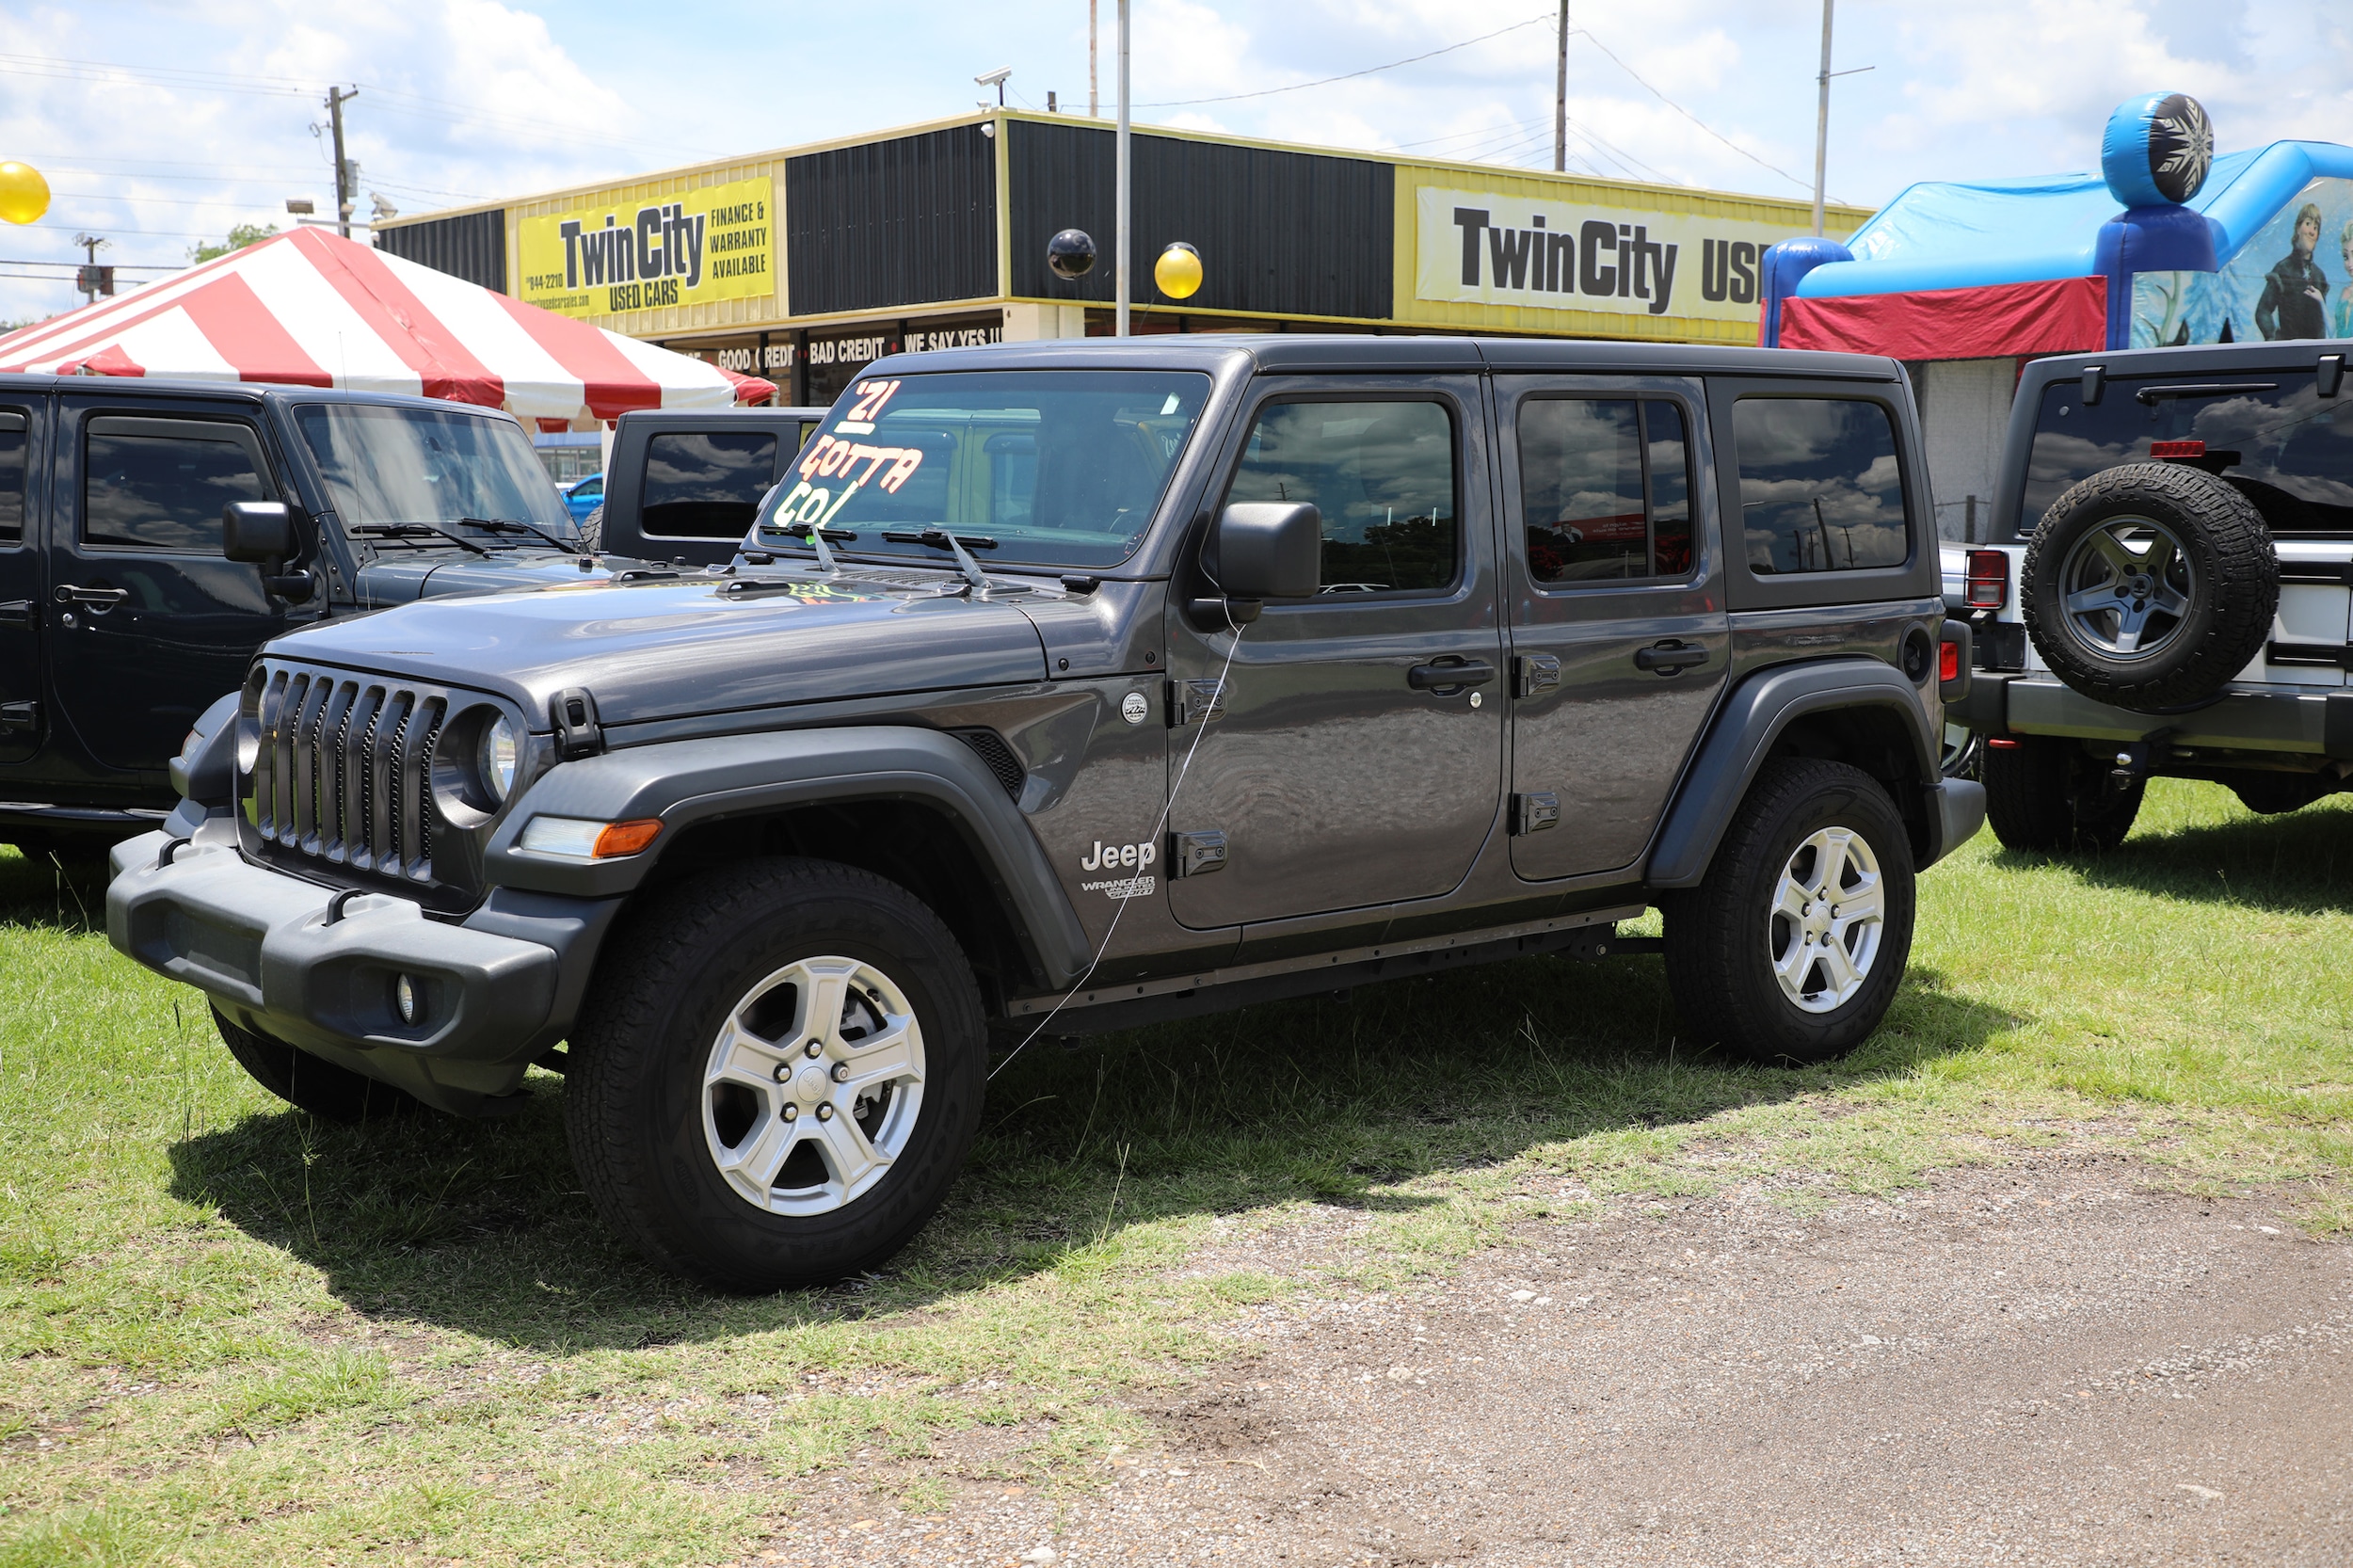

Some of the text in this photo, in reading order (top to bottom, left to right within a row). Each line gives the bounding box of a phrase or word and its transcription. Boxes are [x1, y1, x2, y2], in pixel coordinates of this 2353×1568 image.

[712, 200, 765, 228] FINANCE &
[710, 227, 766, 253] WARRANTY
[712, 254, 766, 280] AVAILABLE
[1702, 238, 1772, 305] US
[610, 279, 679, 312] USED CARS
[718, 348, 751, 371] GOOD
[810, 342, 836, 365] BAD
[838, 336, 885, 363] CREDIT
[904, 333, 925, 353] WE
[928, 330, 955, 351] SAY
[958, 328, 986, 346] YES
[798, 434, 924, 495] GOTTA
[1080, 840, 1157, 871] Jeep
[1081, 875, 1156, 891] WRANGLER
